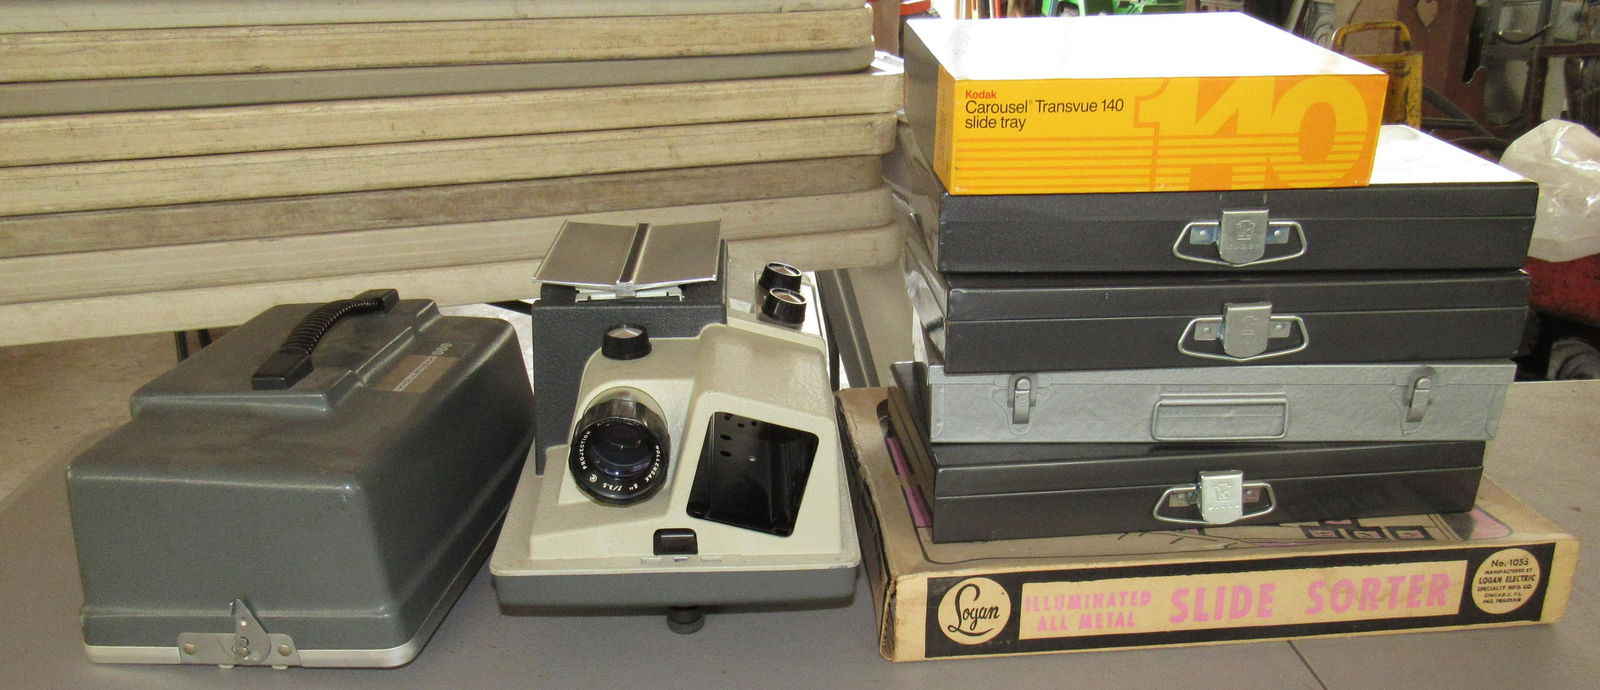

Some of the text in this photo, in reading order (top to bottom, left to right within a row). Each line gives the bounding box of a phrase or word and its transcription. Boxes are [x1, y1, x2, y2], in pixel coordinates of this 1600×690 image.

[965, 90, 997, 99] Kodak
[1035, 100, 1098, 113] Transvue
[1101, 98, 1124, 112] 140
[965, 116, 1026, 131] slide tray
[1133, 74, 1367, 191] 140
[579, 430, 592, 470] PROJECTION
[1479, 574, 1537, 584] LOGAN ELECTRIC
[1024, 590, 1152, 612] ILLUMINATED
[1169, 573, 1450, 623] SLIDE SORTER
[947, 583, 1001, 637] Logan
[1037, 611, 1136, 631] ALL METAL
